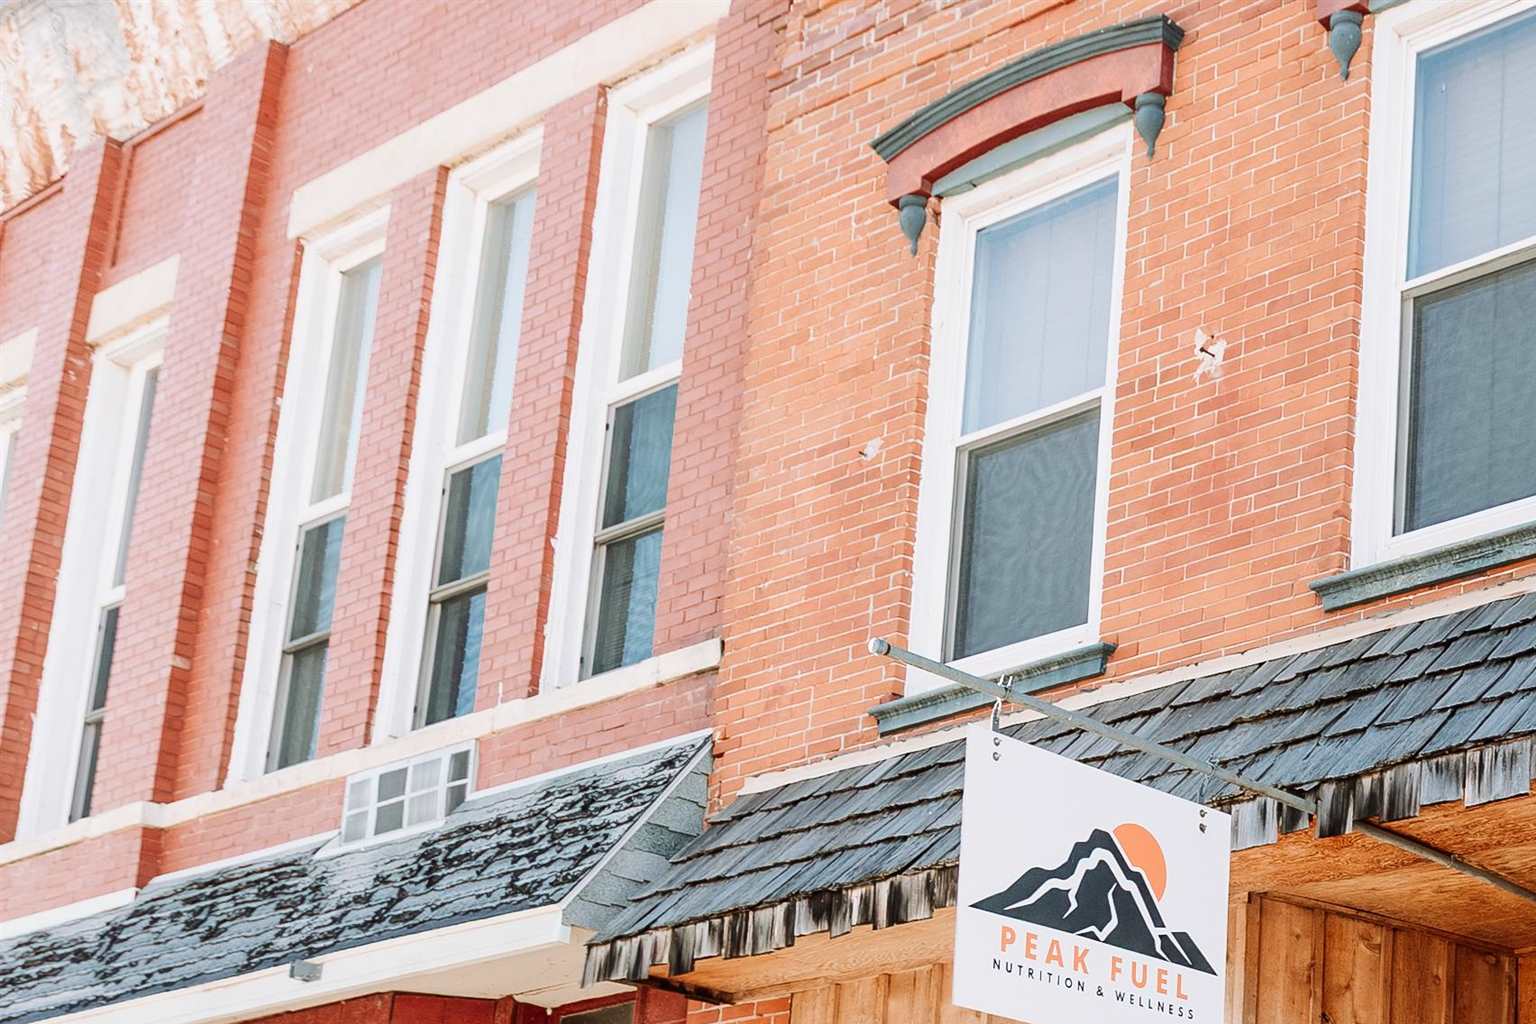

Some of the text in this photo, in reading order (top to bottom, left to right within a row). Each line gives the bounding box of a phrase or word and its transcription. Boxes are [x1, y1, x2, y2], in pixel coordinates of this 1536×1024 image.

[992, 958, 1196, 1020] NUTRITION & WELLNESS
[999, 926, 1189, 1001] PEAK FUEL
